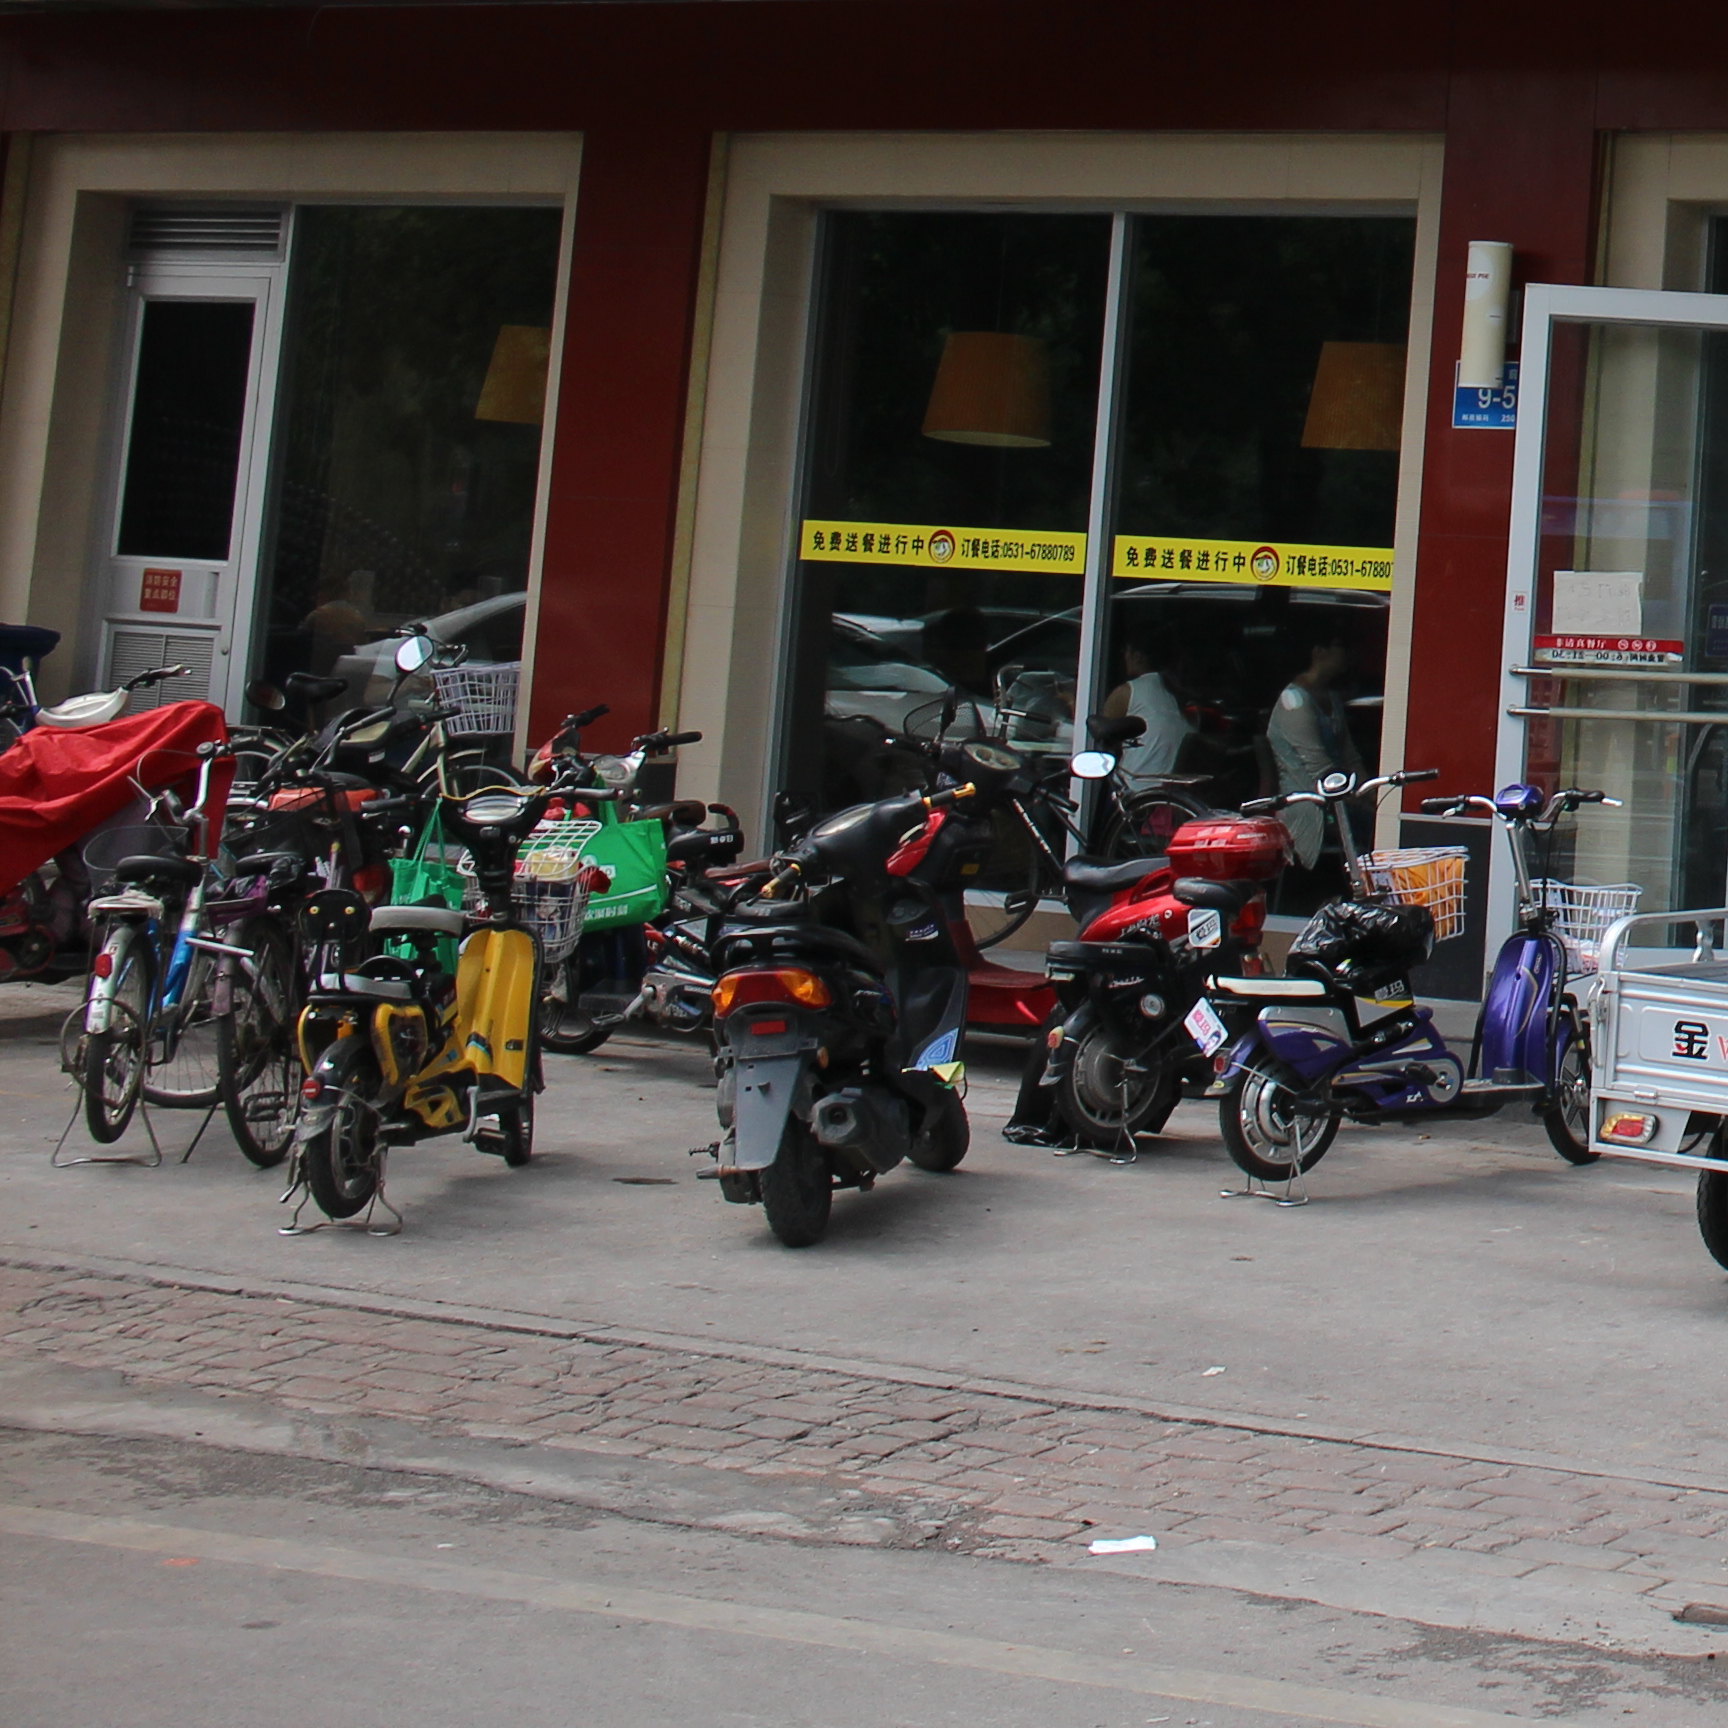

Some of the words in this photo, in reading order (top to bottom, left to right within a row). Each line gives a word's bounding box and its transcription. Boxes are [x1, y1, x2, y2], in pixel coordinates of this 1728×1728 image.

[813, 529, 925, 556] 免费送餐进行中
[1125, 544, 1246, 573] 免费送餐进行中
[1285, 552, 1394, 580] 订餐电话:0531-67880
[1672, 1021, 1709, 1060] 金
